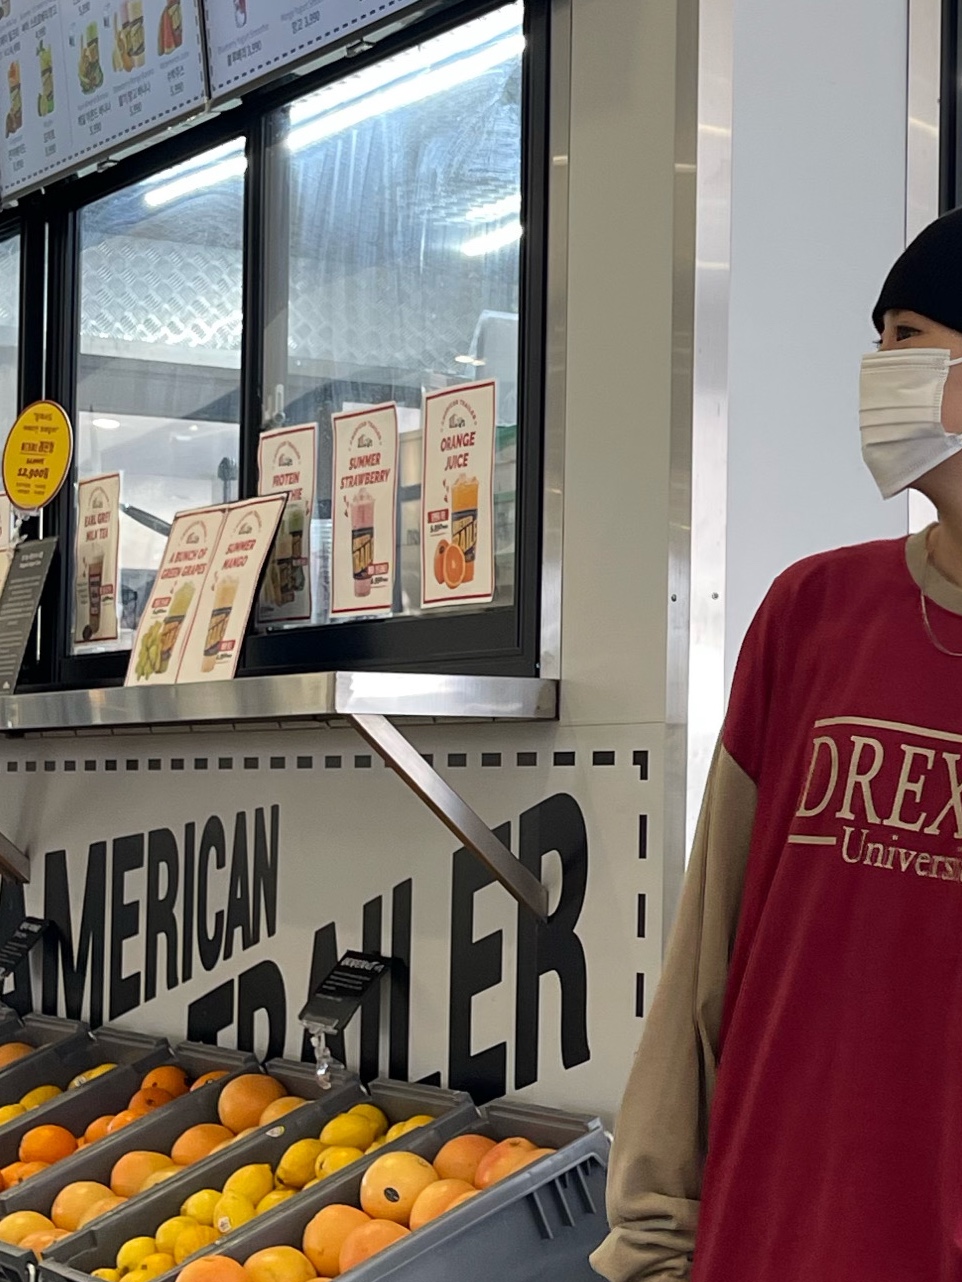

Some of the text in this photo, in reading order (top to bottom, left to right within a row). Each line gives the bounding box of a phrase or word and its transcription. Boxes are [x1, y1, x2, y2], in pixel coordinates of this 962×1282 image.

[440, 430, 477, 453] ORANGE
[348, 452, 381, 471] SUMMER
[444, 452, 470, 472] JUICE
[340, 468, 391, 490] STRAWBERRY
[161, 563, 208, 580] GREEN GRAPES
[222, 555, 249, 571] MANGO
